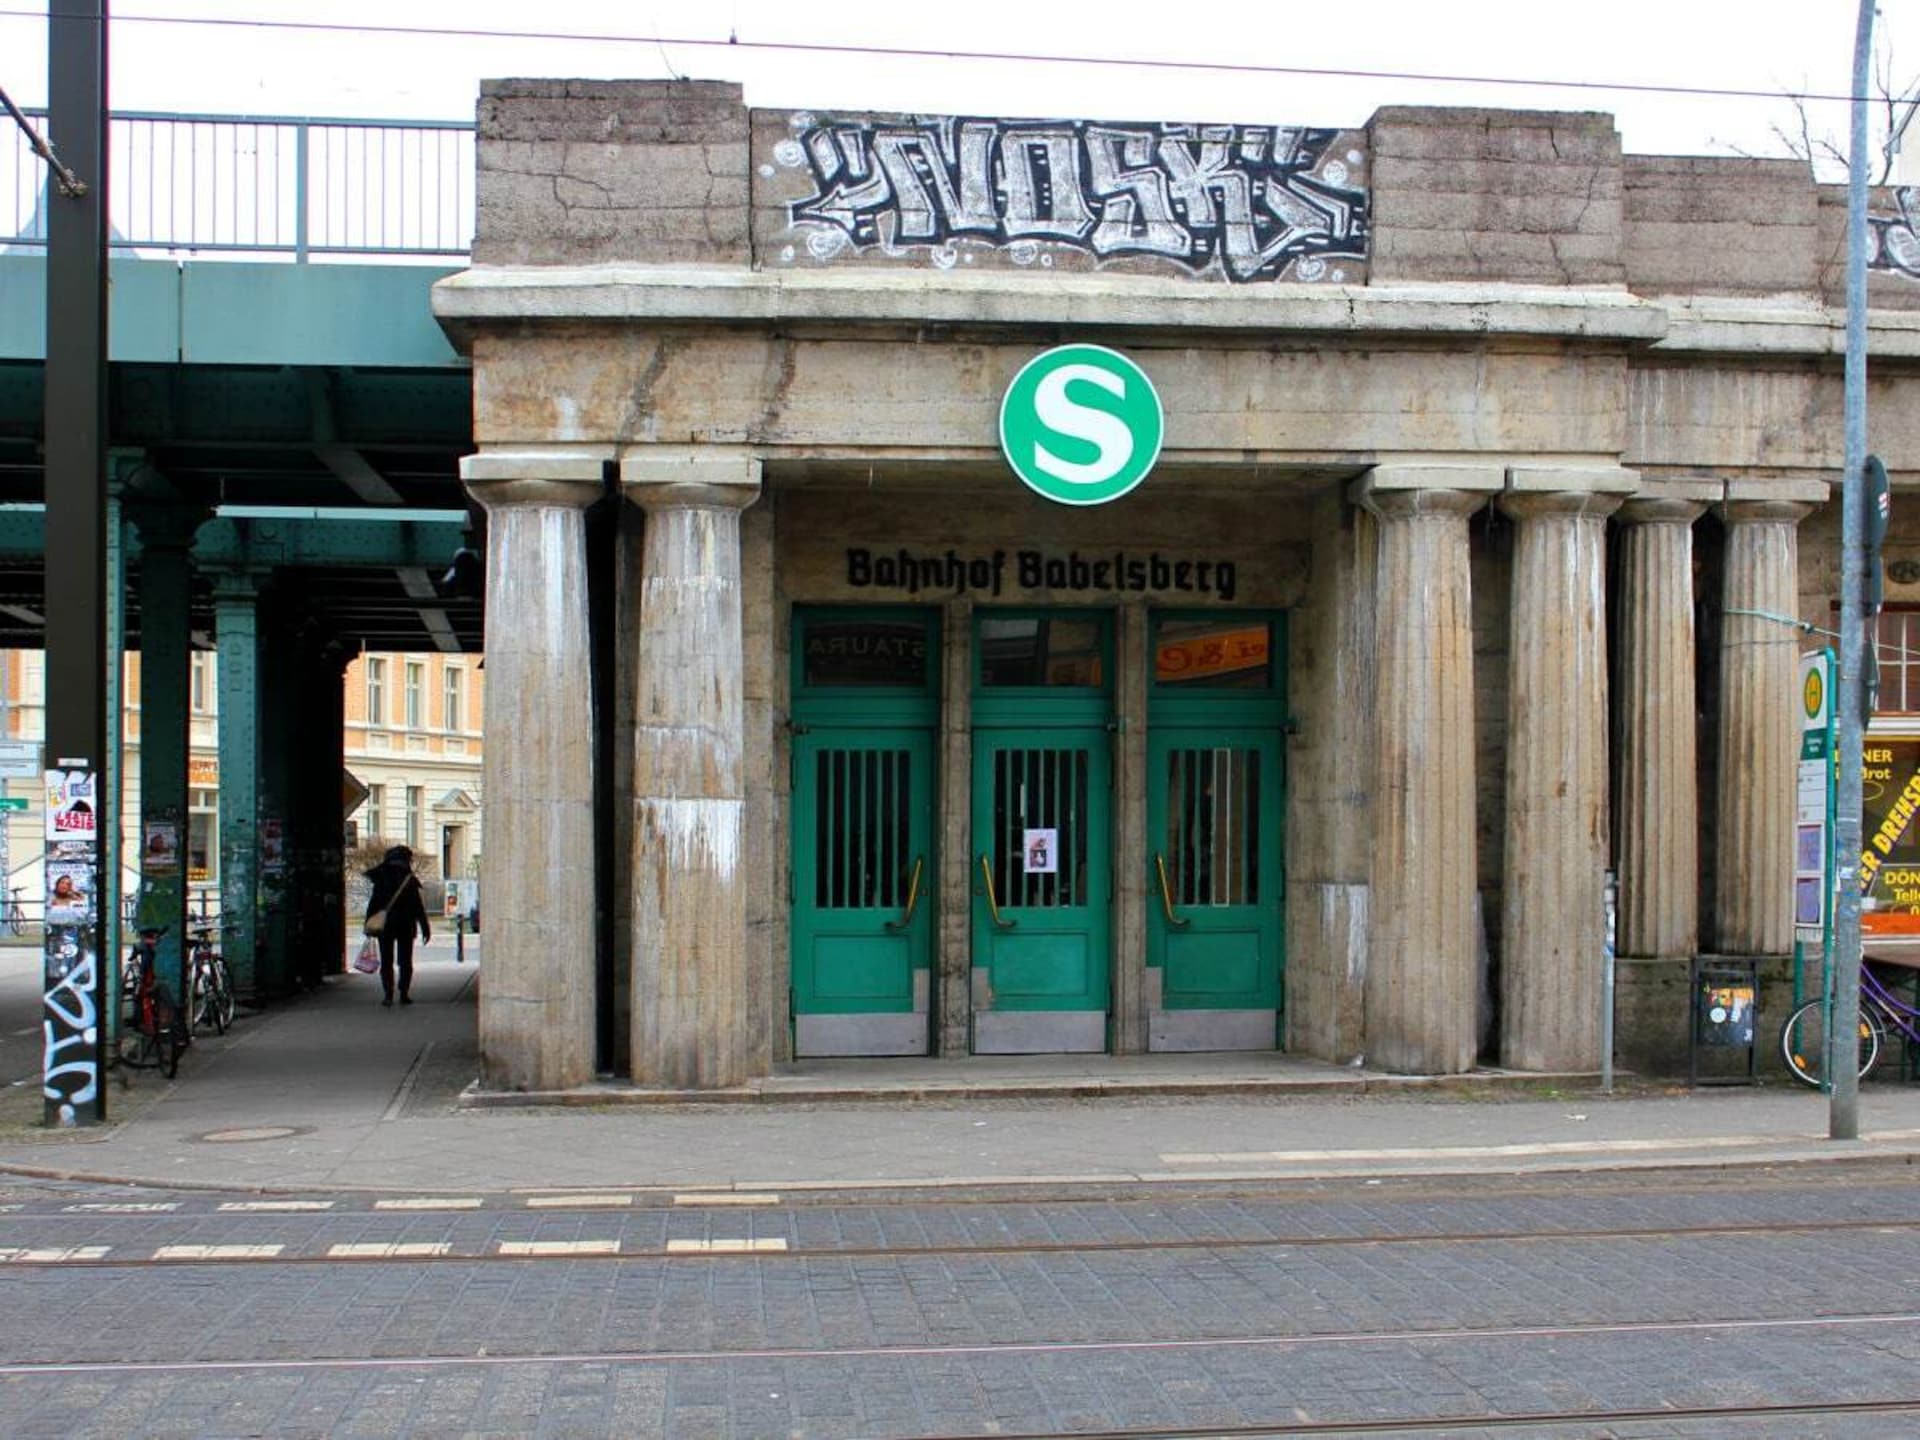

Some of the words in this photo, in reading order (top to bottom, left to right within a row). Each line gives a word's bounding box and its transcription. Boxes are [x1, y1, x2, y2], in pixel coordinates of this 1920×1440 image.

[1034, 364, 1134, 484] S
[847, 548, 1005, 596] Bahnhof
[1018, 550, 1236, 600] Babelsberg
